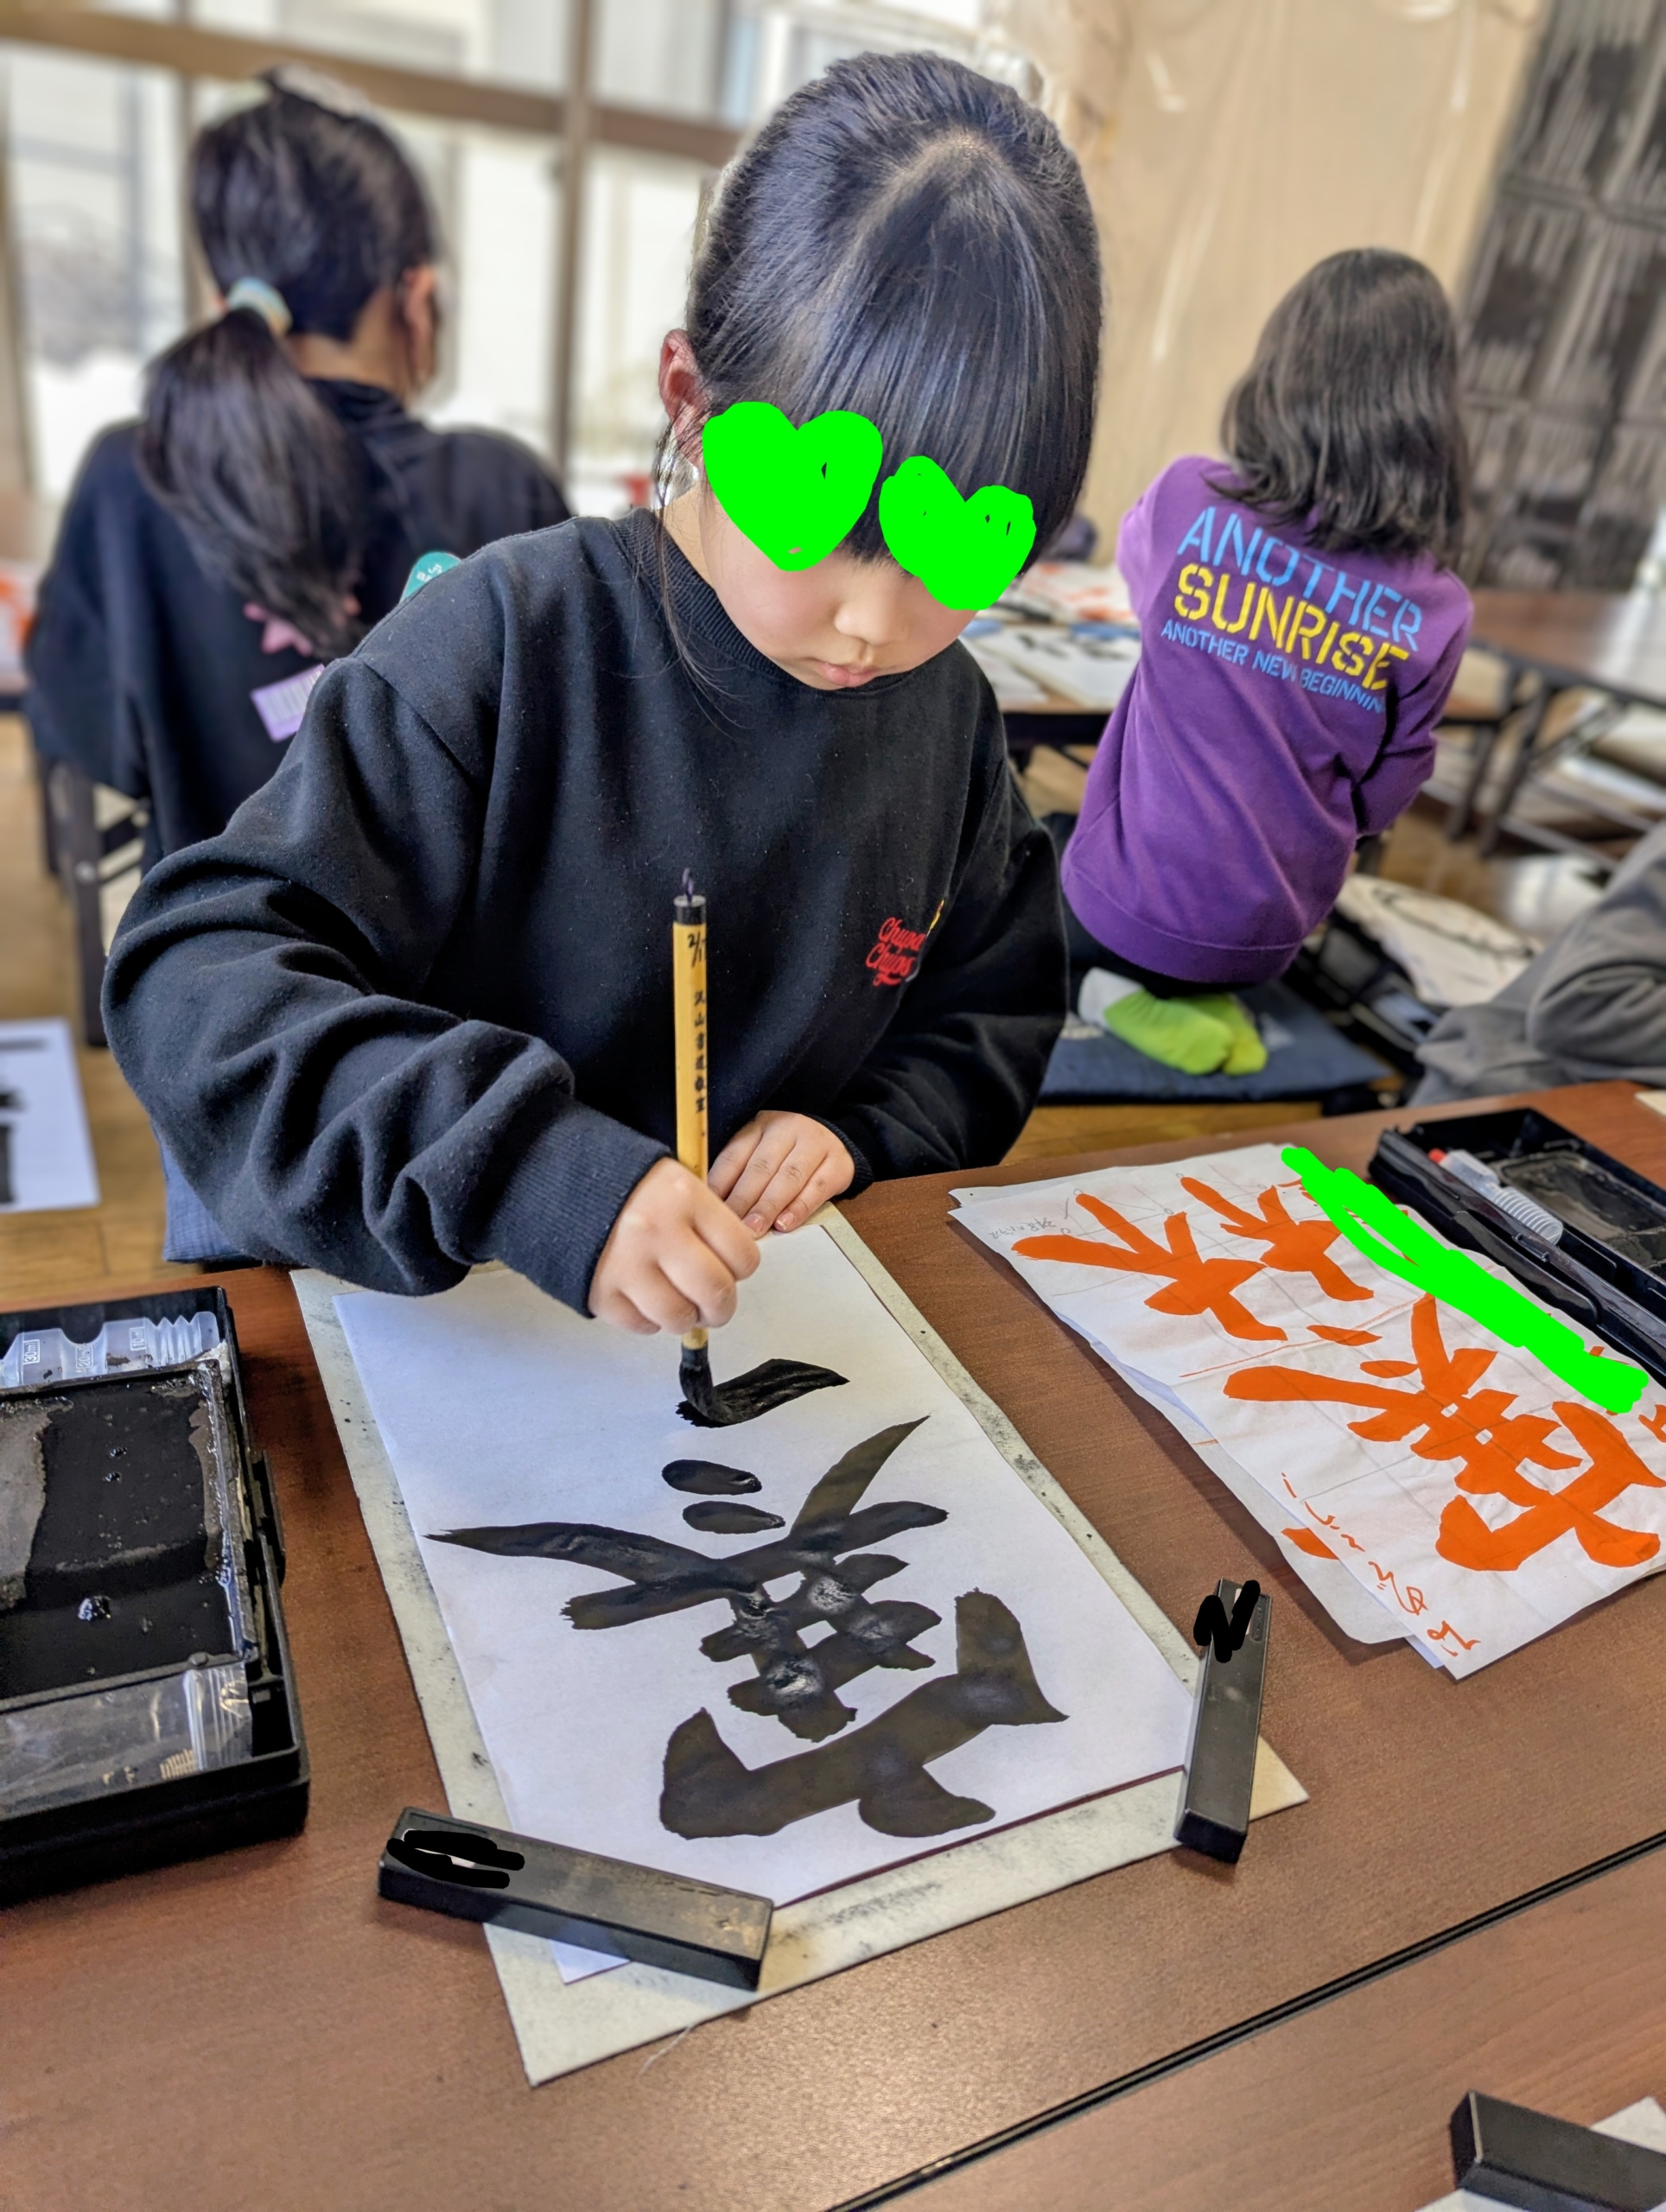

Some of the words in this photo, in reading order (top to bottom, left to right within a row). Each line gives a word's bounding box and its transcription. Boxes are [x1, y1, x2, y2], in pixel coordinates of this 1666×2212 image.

[1173, 562, 1410, 691] SUNRISE
[1177, 505, 1422, 652] ANOTHER
[1160, 618, 1250, 666] ANOTHER
[1252, 649, 1296, 683] NEW
[23, 1341, 37, 1363] 30ml
